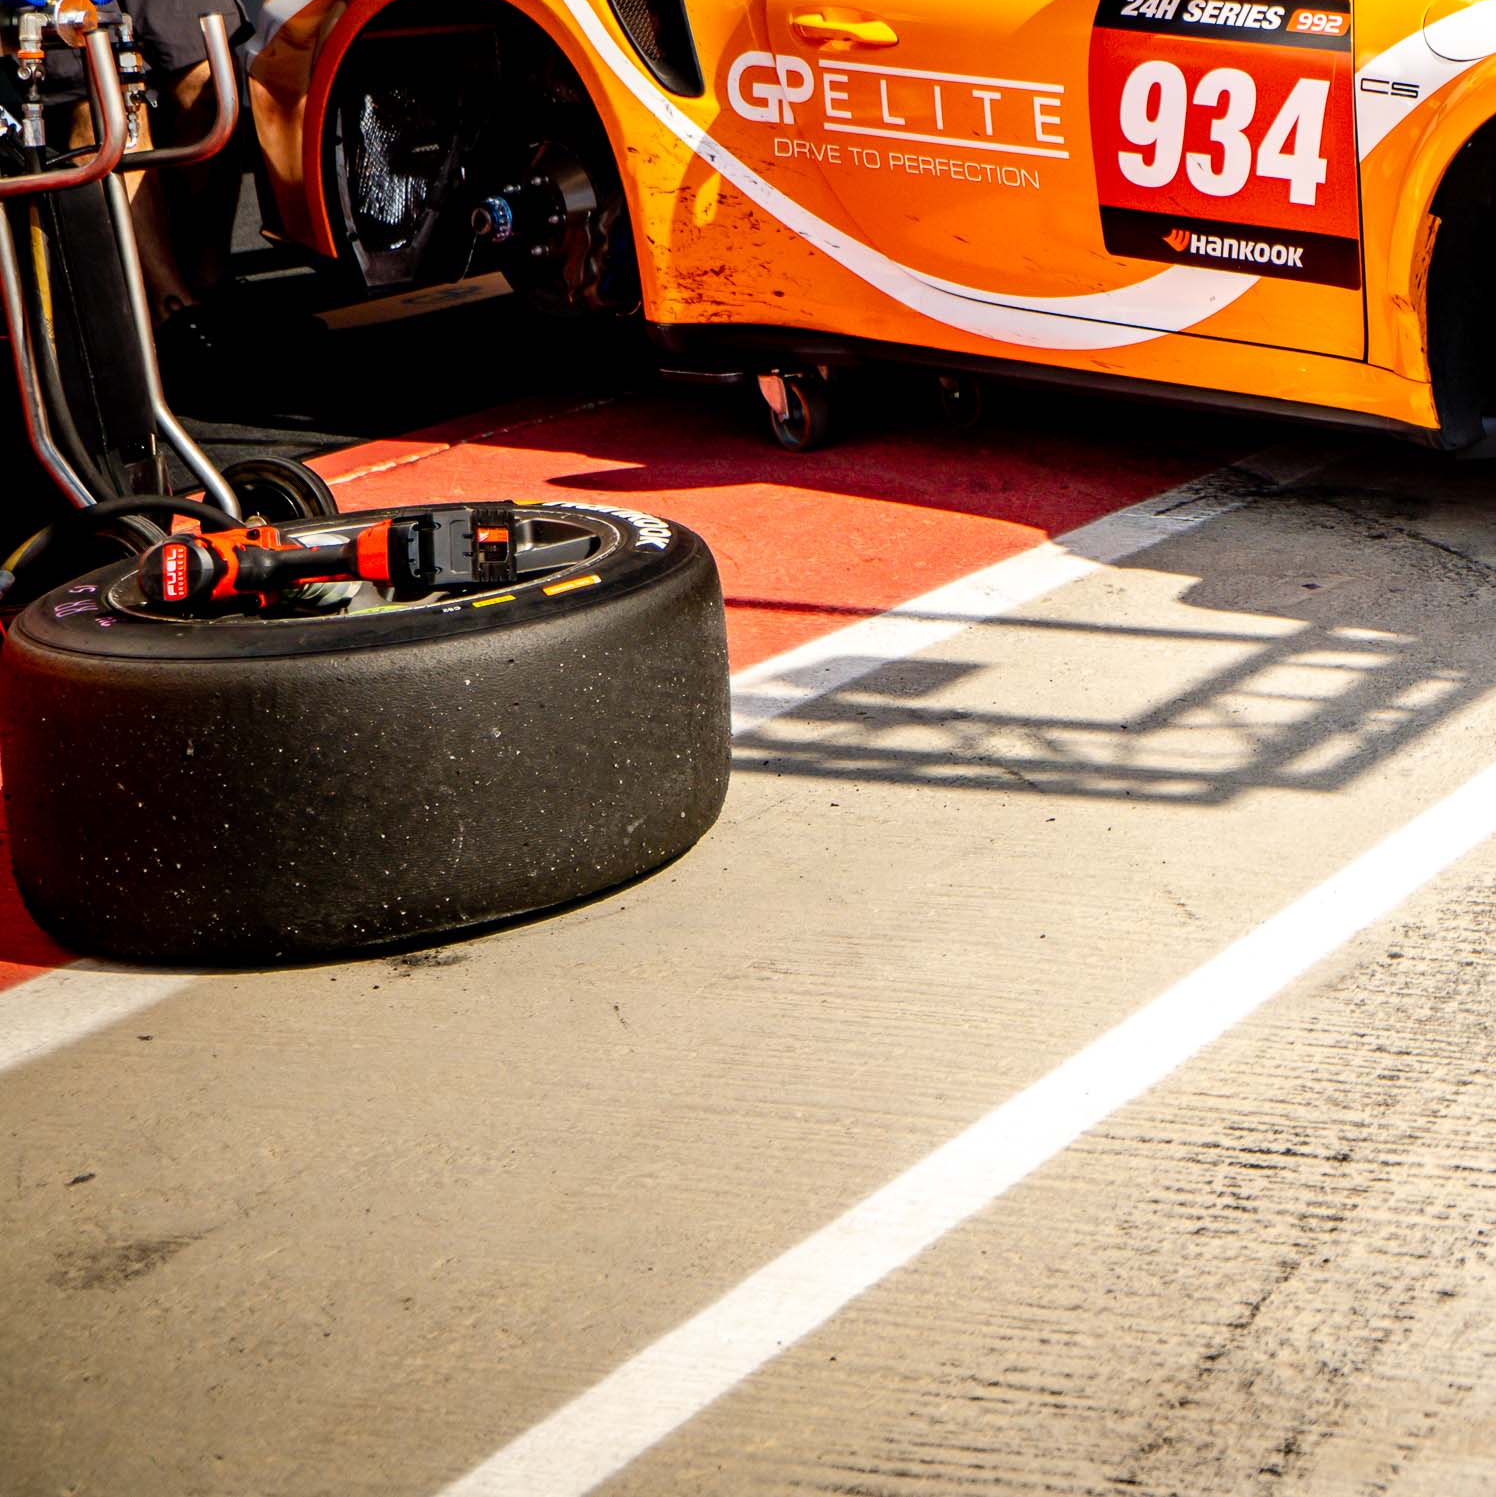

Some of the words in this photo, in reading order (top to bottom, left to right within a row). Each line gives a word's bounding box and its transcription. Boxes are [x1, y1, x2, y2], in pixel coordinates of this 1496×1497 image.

[1296, 11, 1344, 34] 992
[726, 49, 816, 126] GP
[818, 64, 1070, 153] ELITE
[1117, 59, 1331, 207] 934
[847, 147, 881, 170] TO
[888, 153, 1041, 190] PERFECTION
[1190, 232, 1305, 268] HANKOOK
[166, 549, 178, 596] FUEL
